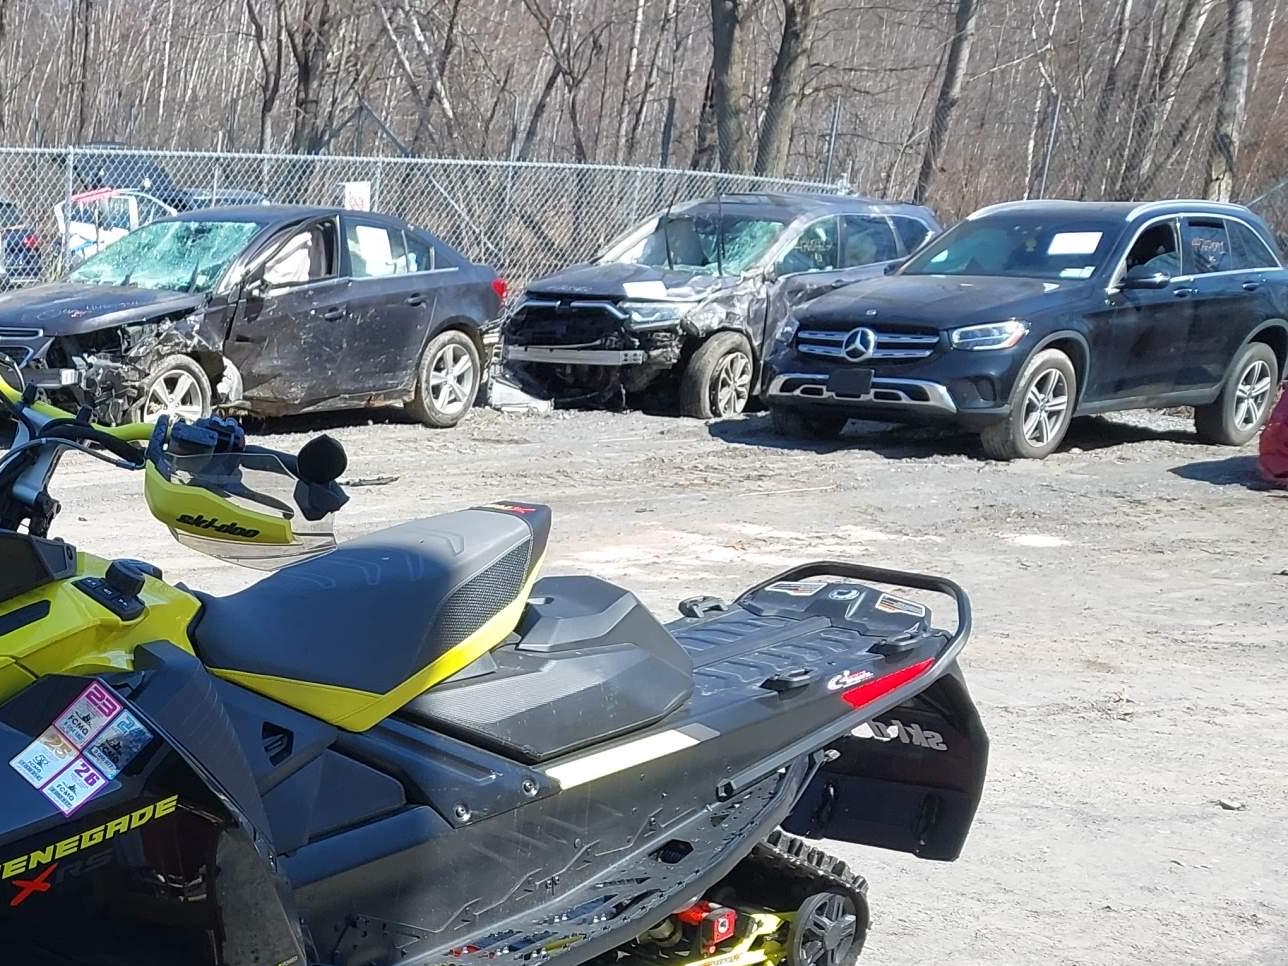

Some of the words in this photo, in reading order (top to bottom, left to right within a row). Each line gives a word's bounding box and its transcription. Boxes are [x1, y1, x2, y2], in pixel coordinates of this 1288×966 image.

[175, 514, 260, 538] ski-doo
[86, 685, 117, 718] 23
[74, 763, 100, 786] 26
